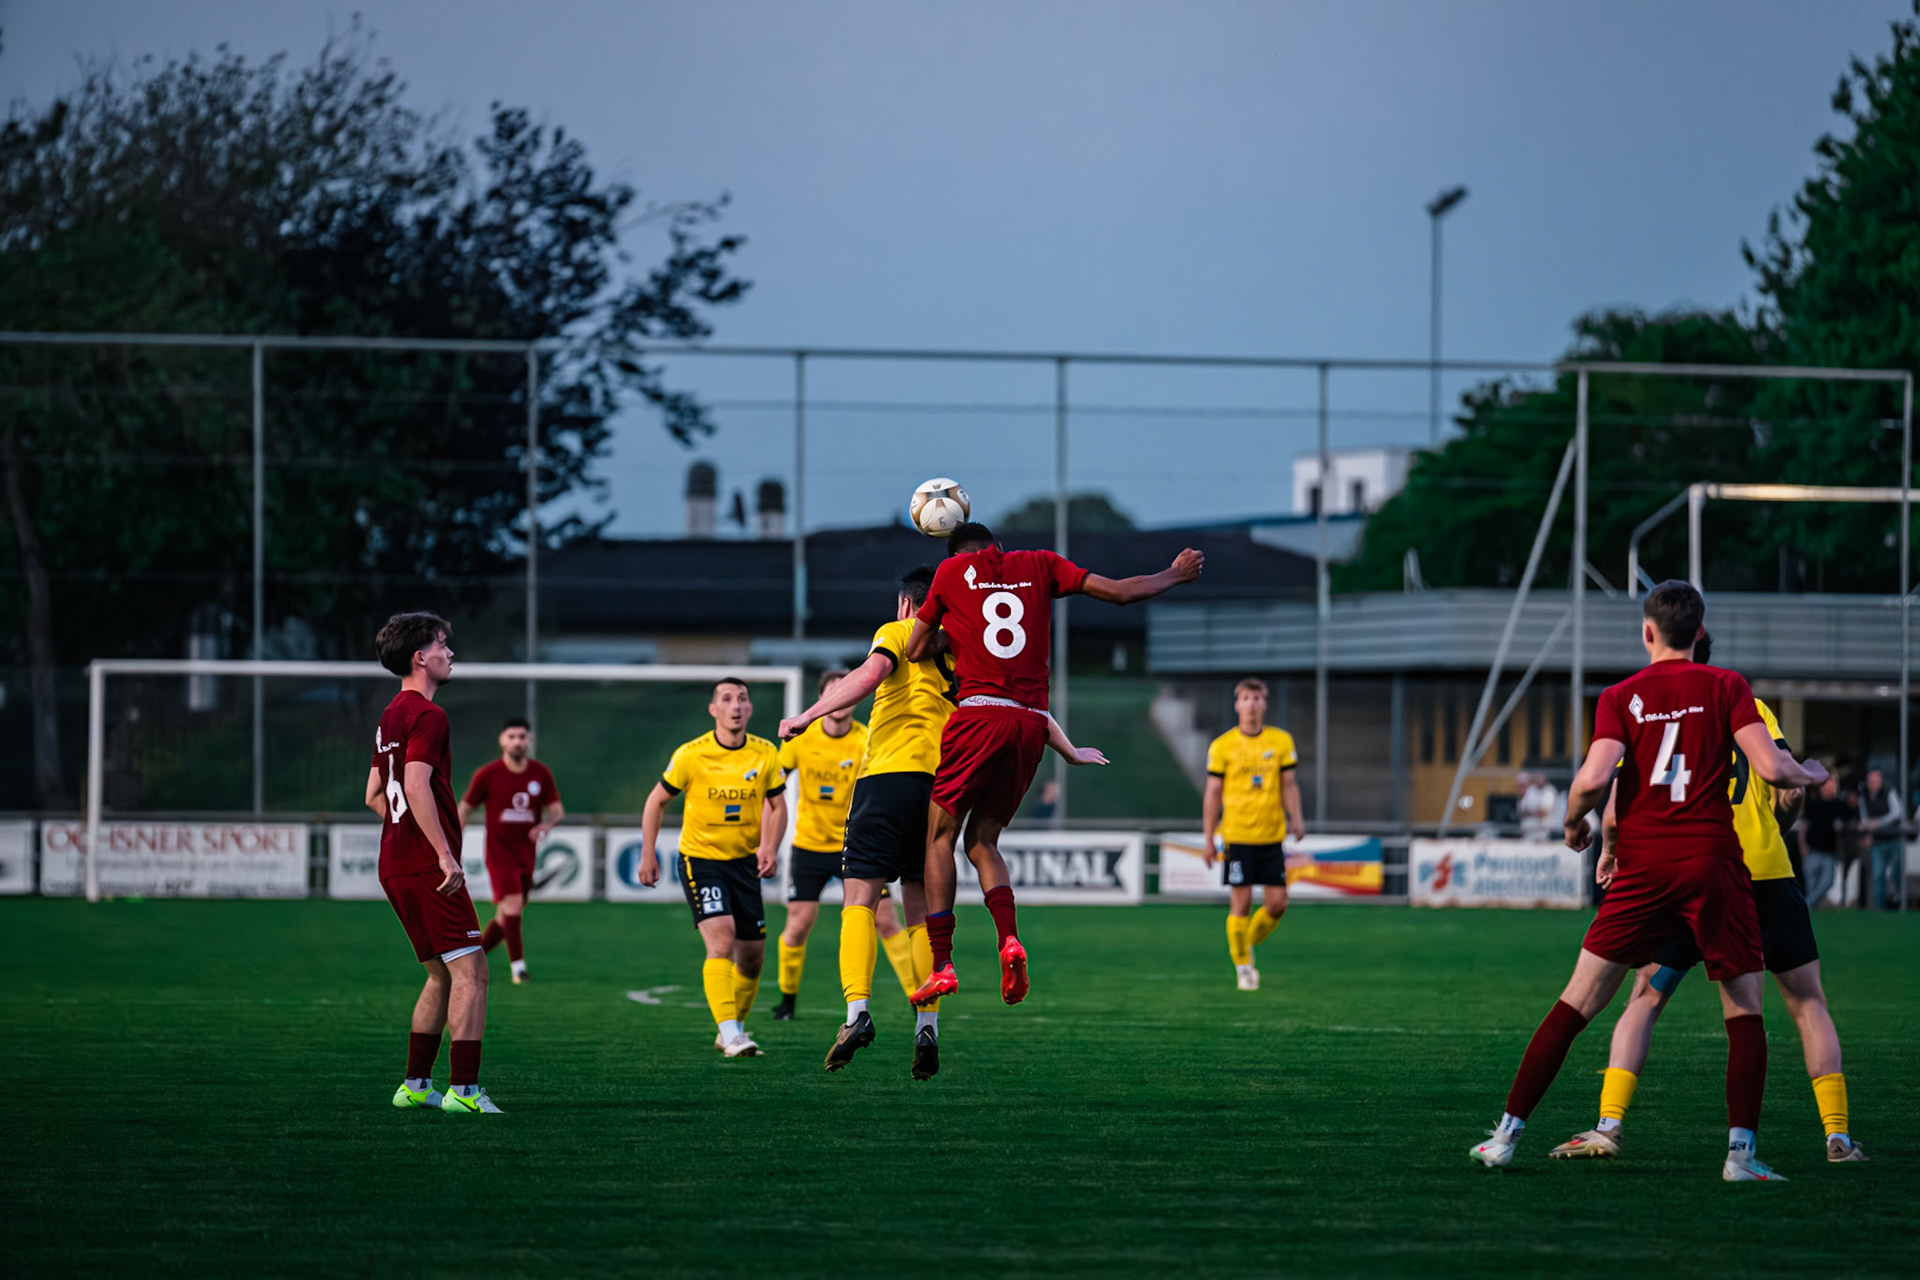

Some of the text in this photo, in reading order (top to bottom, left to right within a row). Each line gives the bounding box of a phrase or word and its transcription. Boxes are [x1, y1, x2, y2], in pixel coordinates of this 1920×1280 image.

[982, 591, 1027, 659] 8
[1649, 722, 1692, 802] 4
[708, 786, 757, 800] PADEA
[202, 824, 297, 856] SPORT
[701, 886, 722, 902] 20
